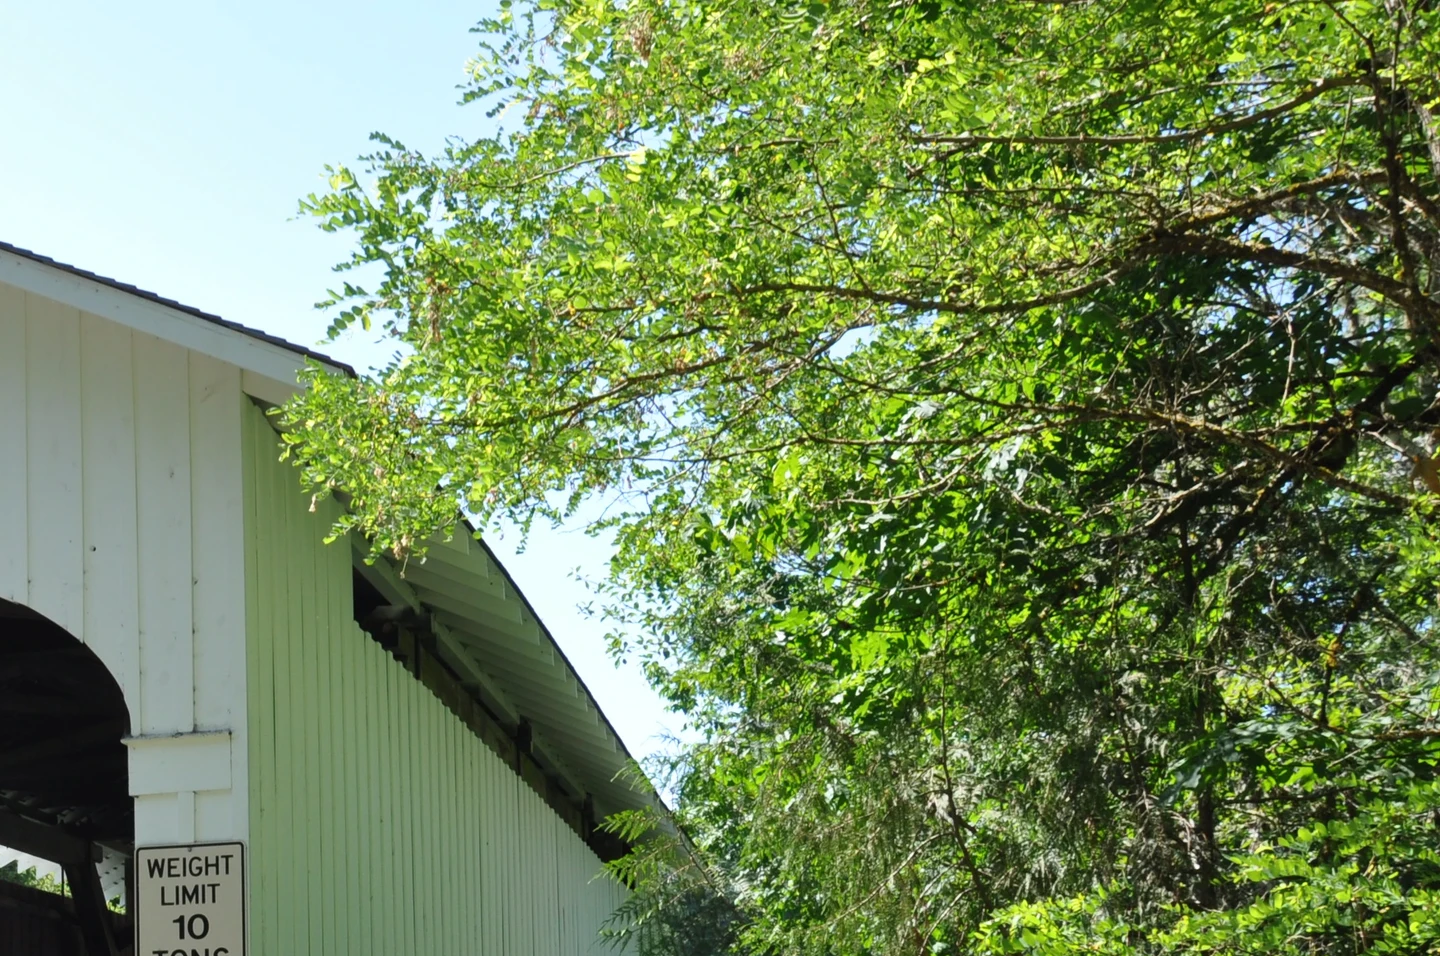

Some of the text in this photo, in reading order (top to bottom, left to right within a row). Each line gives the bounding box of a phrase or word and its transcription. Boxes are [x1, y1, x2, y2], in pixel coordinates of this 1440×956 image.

[147, 854, 234, 879] WEIGHT
[160, 883, 220, 906] LIMIT
[172, 913, 210, 940] 10
